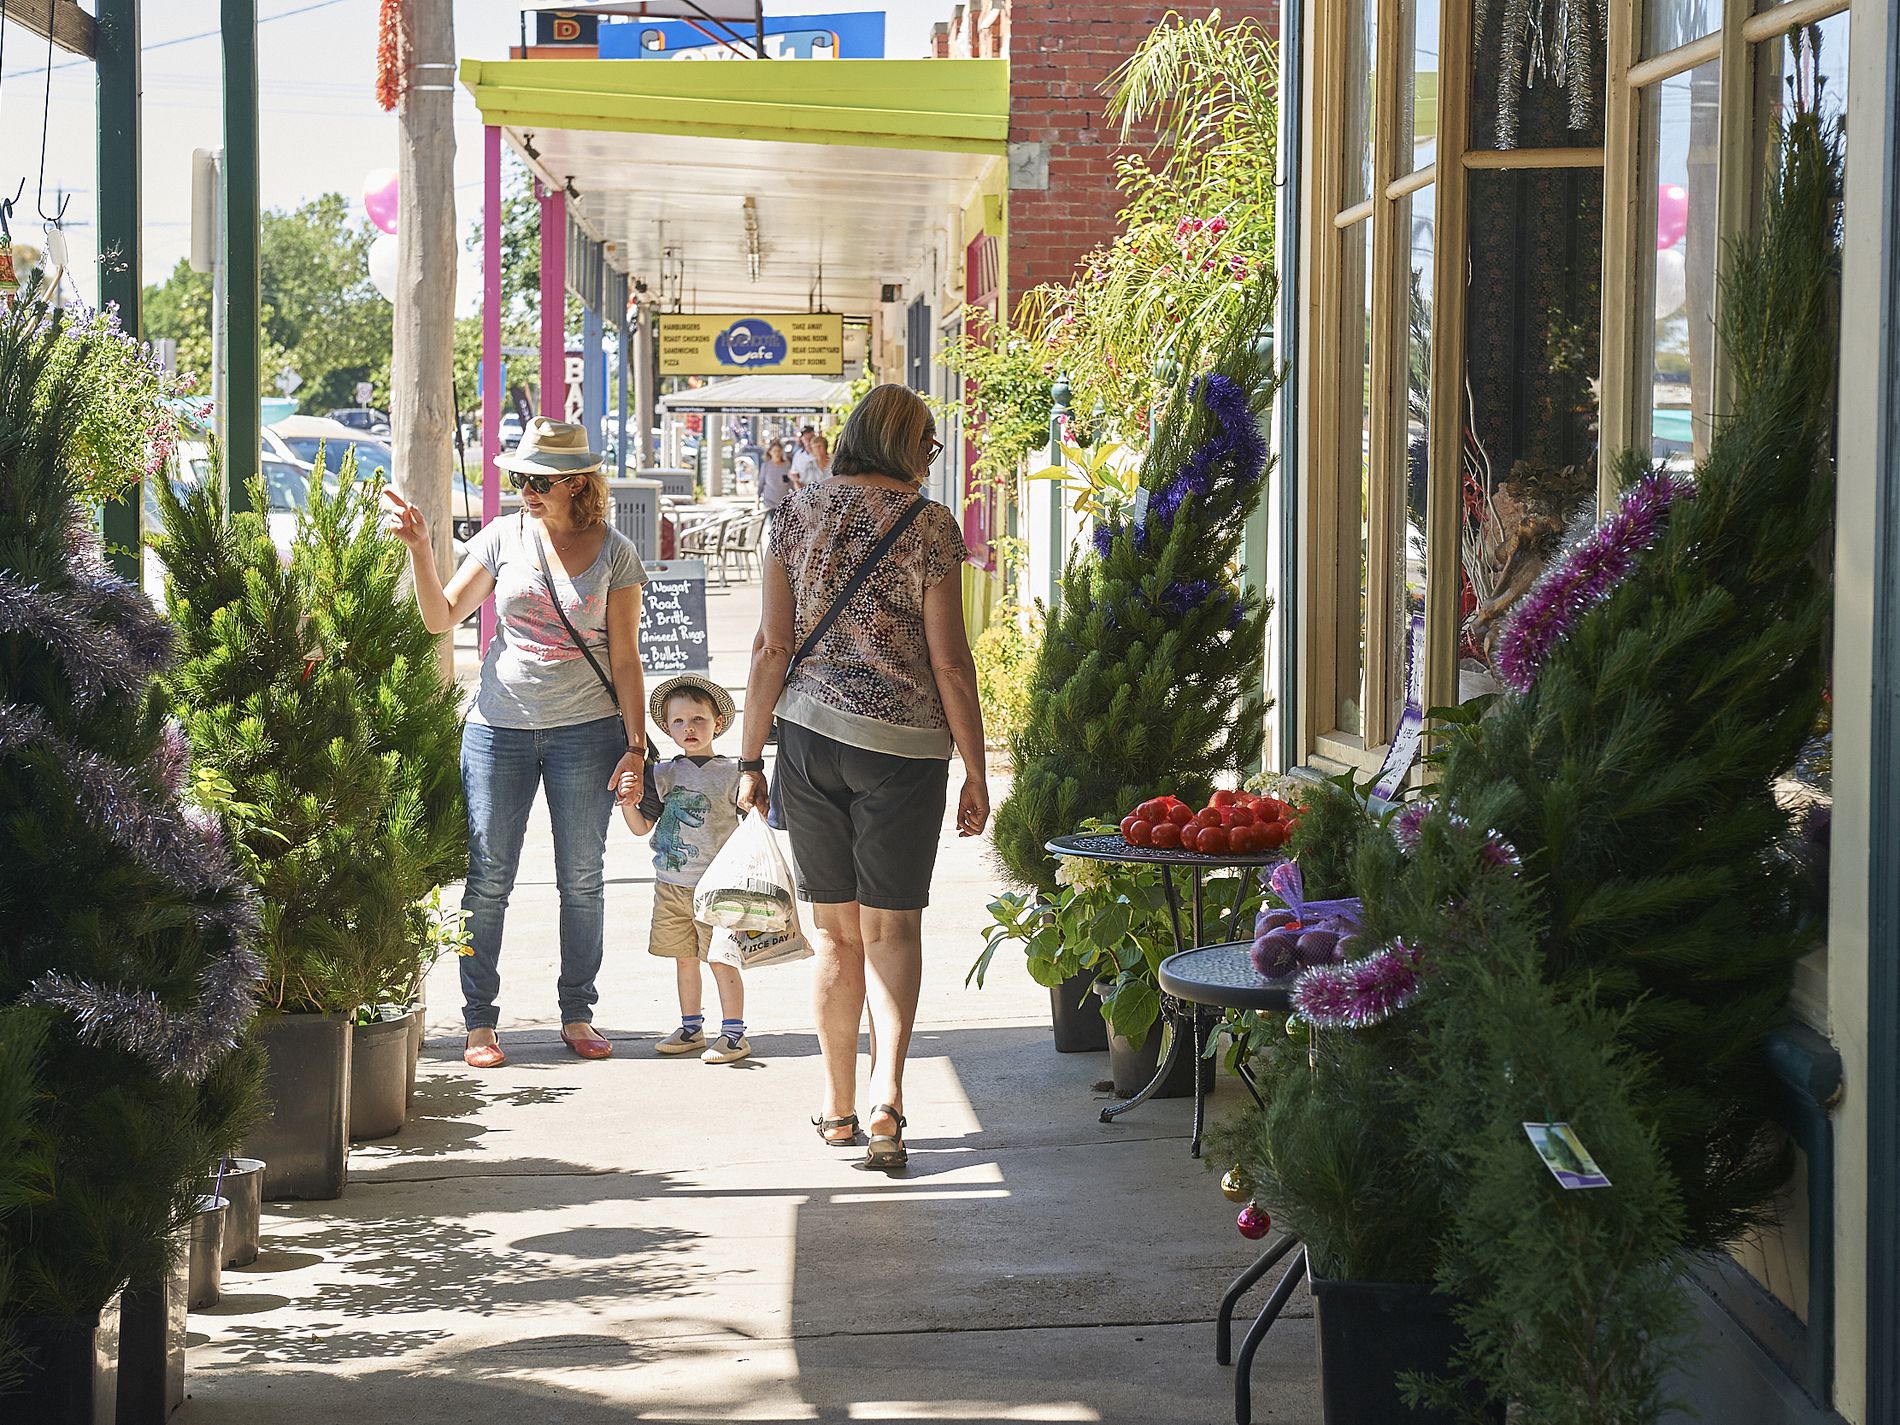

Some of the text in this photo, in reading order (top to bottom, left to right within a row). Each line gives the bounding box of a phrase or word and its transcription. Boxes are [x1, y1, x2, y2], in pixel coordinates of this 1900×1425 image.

[552, 12, 581, 40] D
[728, 326, 773, 364] Cafe
[792, 346, 840, 354] REAR COURTYARD
[807, 358, 827, 366] ROOMS
[651, 580, 692, 596] Nougat
[647, 595, 681, 610] Road
[655, 610, 693, 625] Brittle
[641, 627, 678, 643] Aniseed
[650, 644, 689, 661] Bullets
[772, 933, 789, 945] DAY
